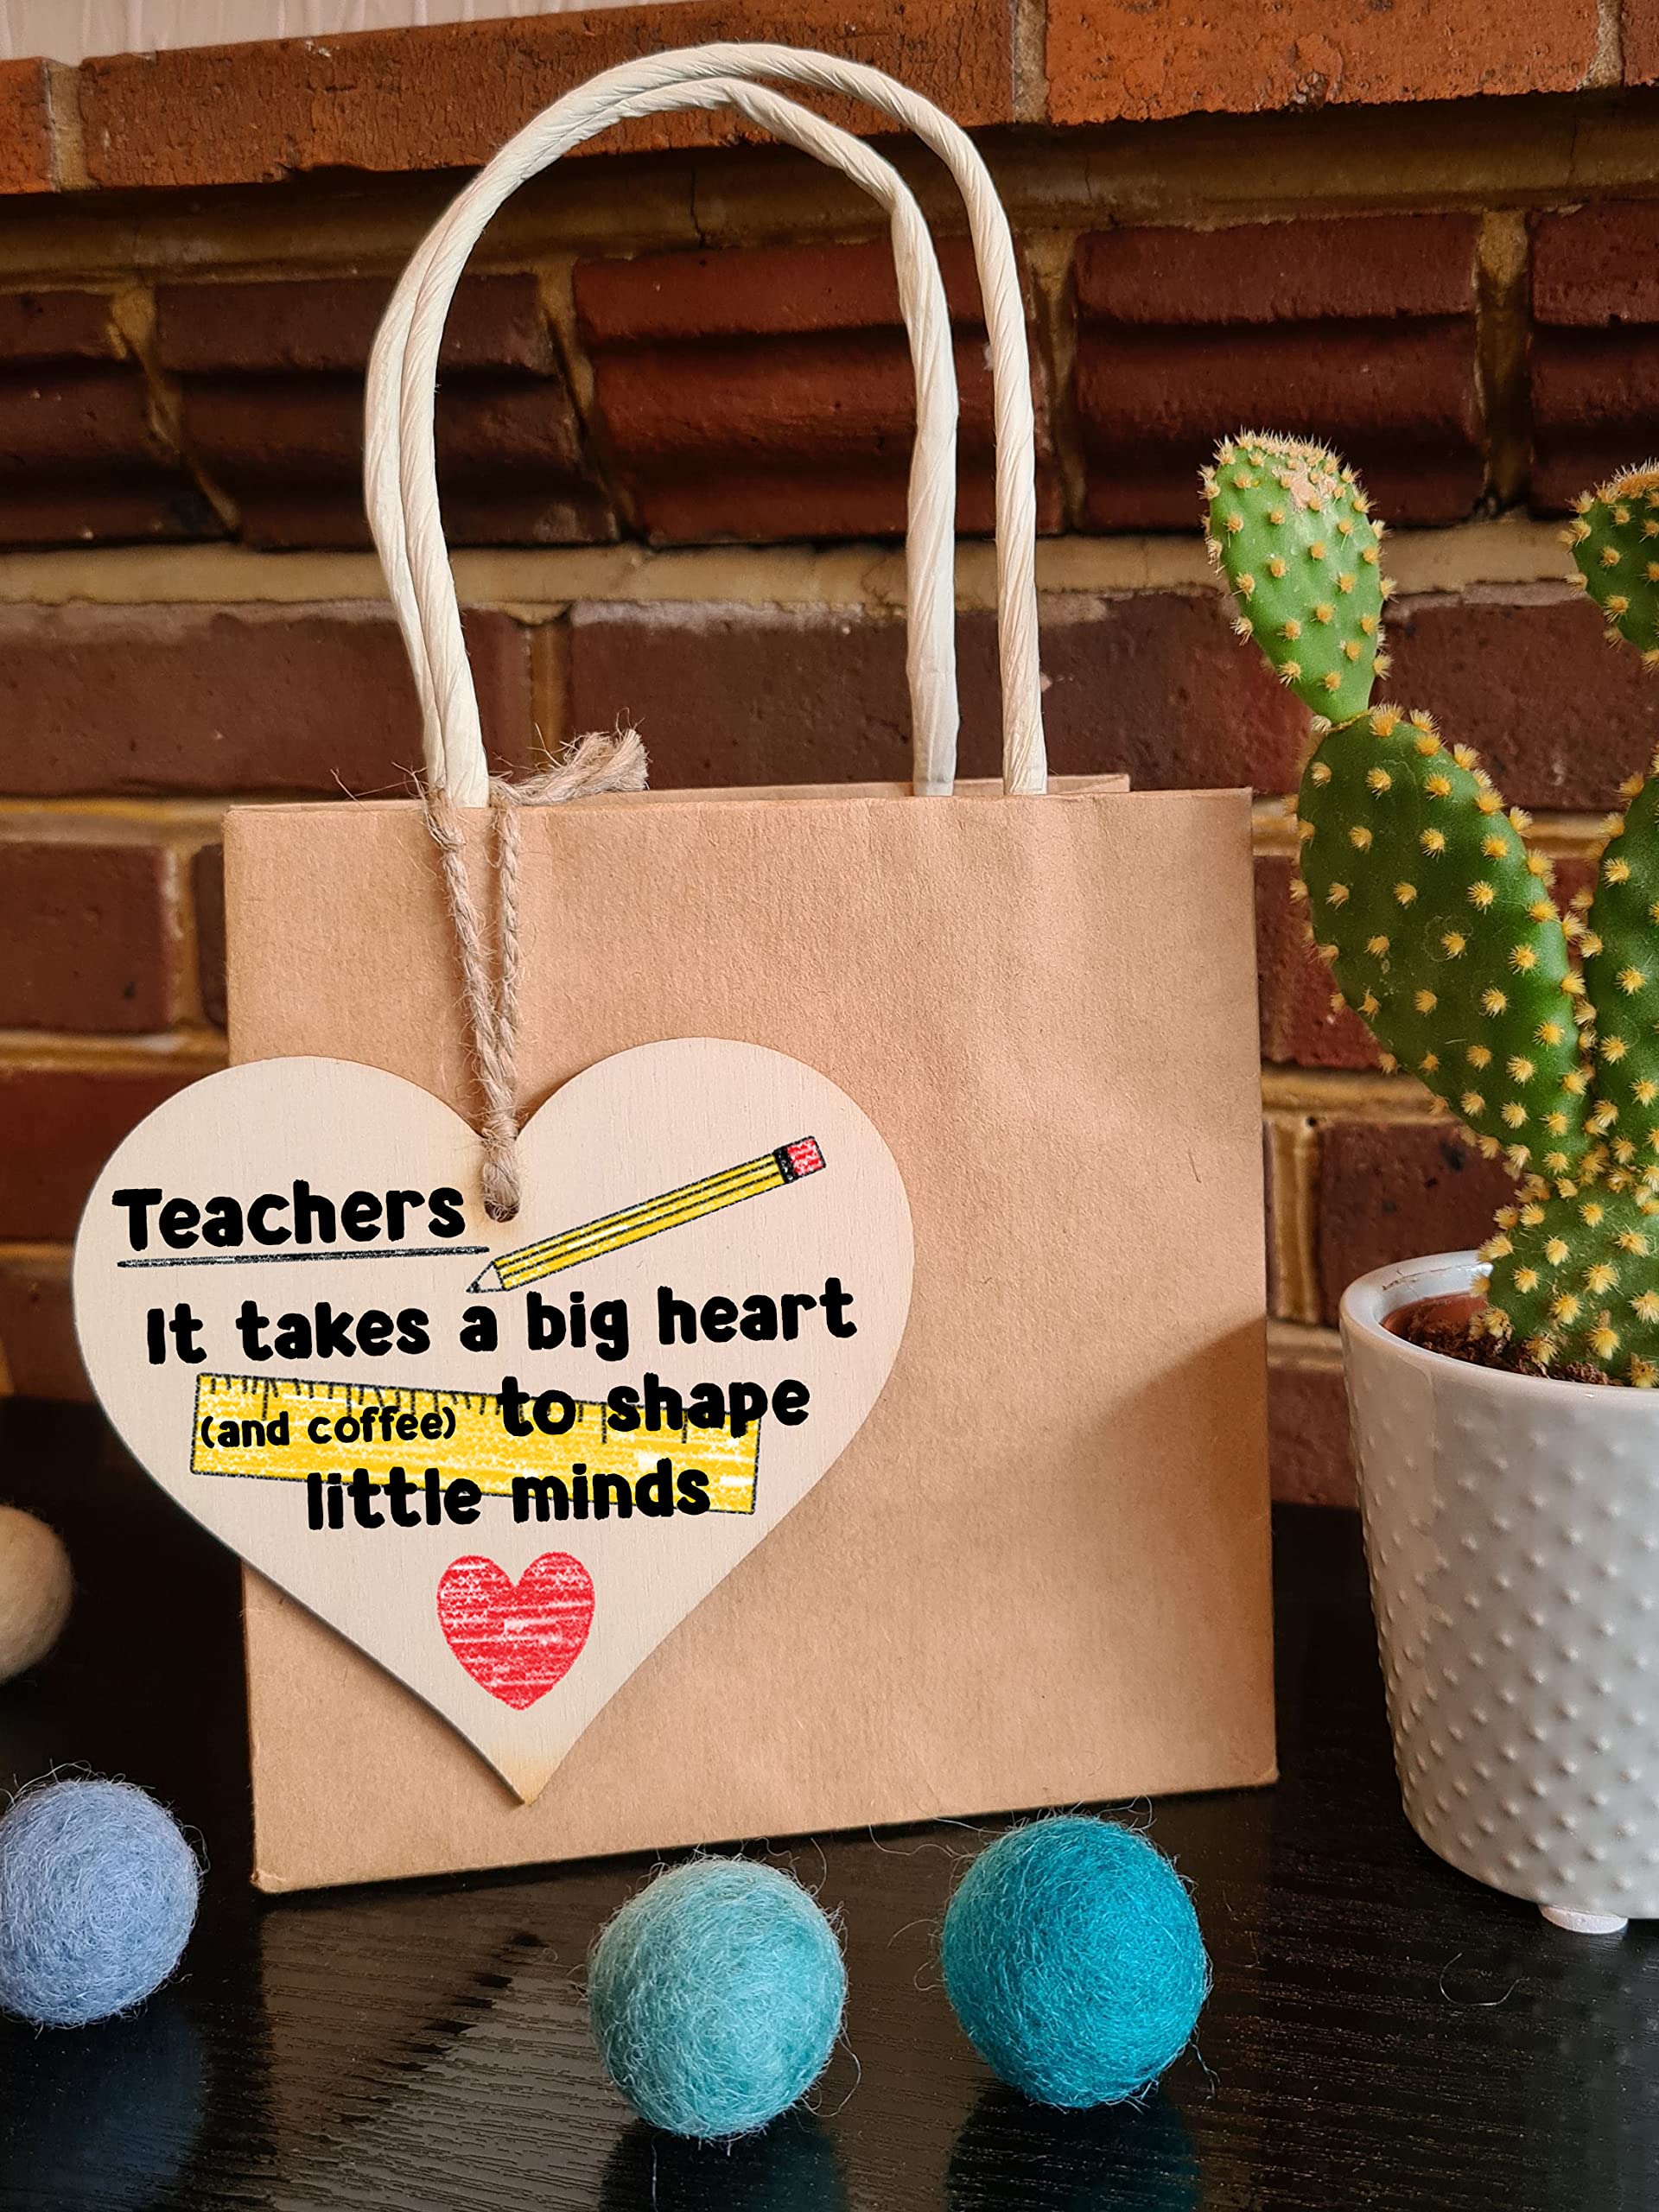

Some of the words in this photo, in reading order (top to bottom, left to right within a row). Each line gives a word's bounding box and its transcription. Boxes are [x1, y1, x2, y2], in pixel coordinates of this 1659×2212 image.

[112, 1179, 466, 1251] Teachers
[147, 1303, 207, 1365] It
[235, 1300, 430, 1362] takes
[460, 1306, 498, 1352] a
[526, 1291, 629, 1362] big
[657, 1277, 858, 1345] heart
[200, 1411, 290, 1449] (and
[307, 1406, 456, 1444] coffee)
[496, 1376, 576, 1437] to
[607, 1372, 810, 1438] shape
[307, 1466, 482, 1530] little
[512, 1457, 711, 1523] minds
